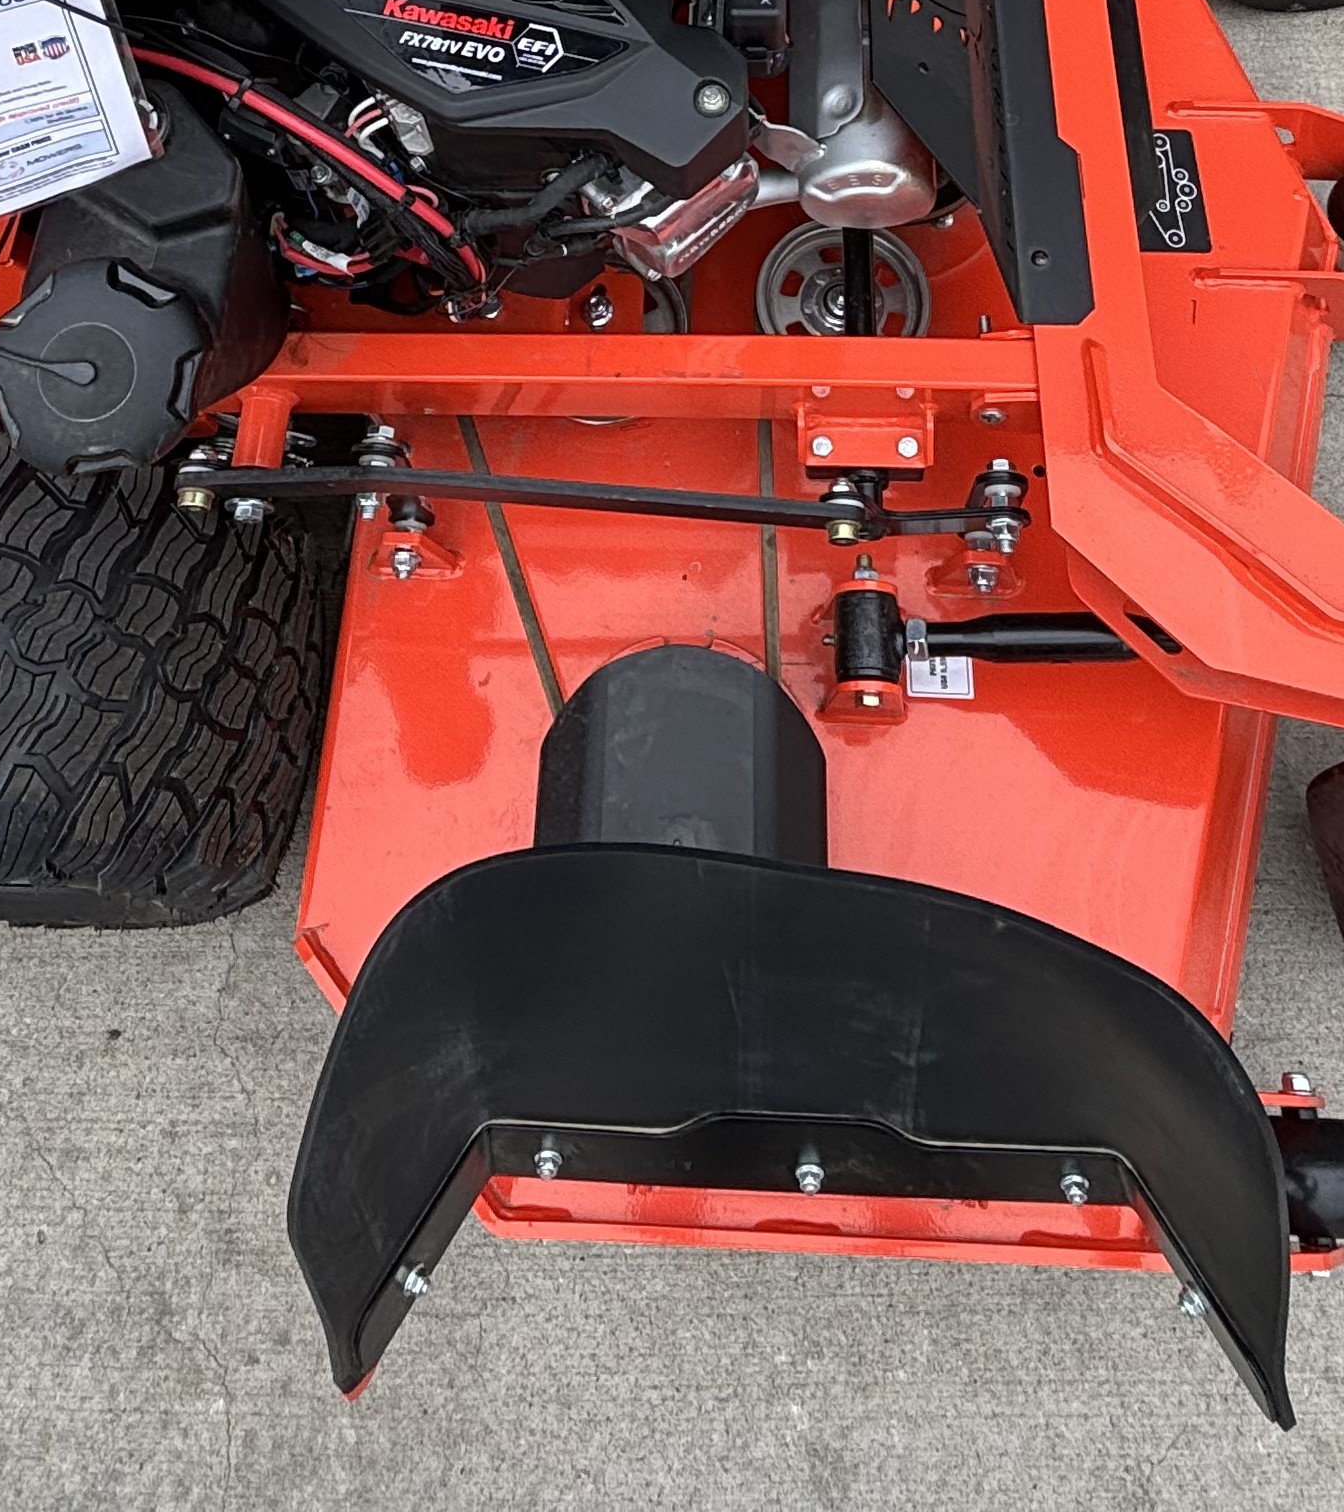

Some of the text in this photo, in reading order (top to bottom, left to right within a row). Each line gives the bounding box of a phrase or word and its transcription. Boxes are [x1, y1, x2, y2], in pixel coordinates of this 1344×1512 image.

[399, 30, 506, 63] FX781V EVO
[517, 37, 556, 56] EFI
